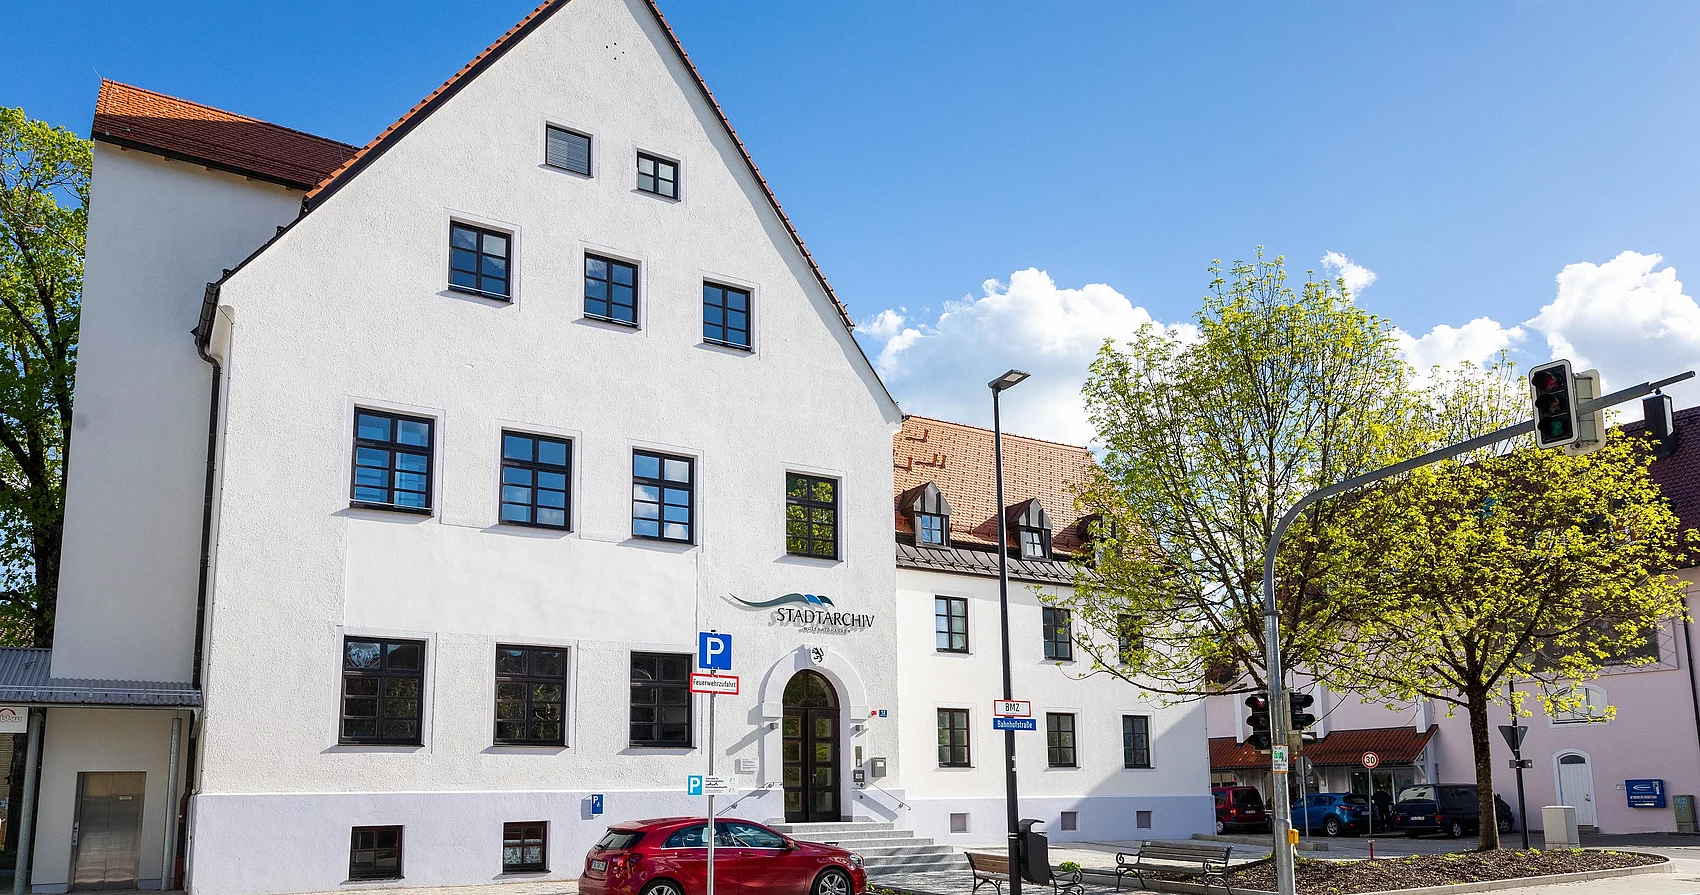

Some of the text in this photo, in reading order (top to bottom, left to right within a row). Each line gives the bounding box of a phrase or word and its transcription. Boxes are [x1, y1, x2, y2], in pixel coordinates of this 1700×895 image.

[777, 608, 875, 628] STADTARCHIV
[706, 636, 725, 665] P
[693, 678, 736, 688] Feuerwehrzufahrt
[1005, 702, 1020, 712] BMZ
[997, 720, 1033, 729] Bahnhofstraße
[1365, 755, 1376, 764] 30
[690, 777, 700, 793] P
[593, 795, 599, 804] P
